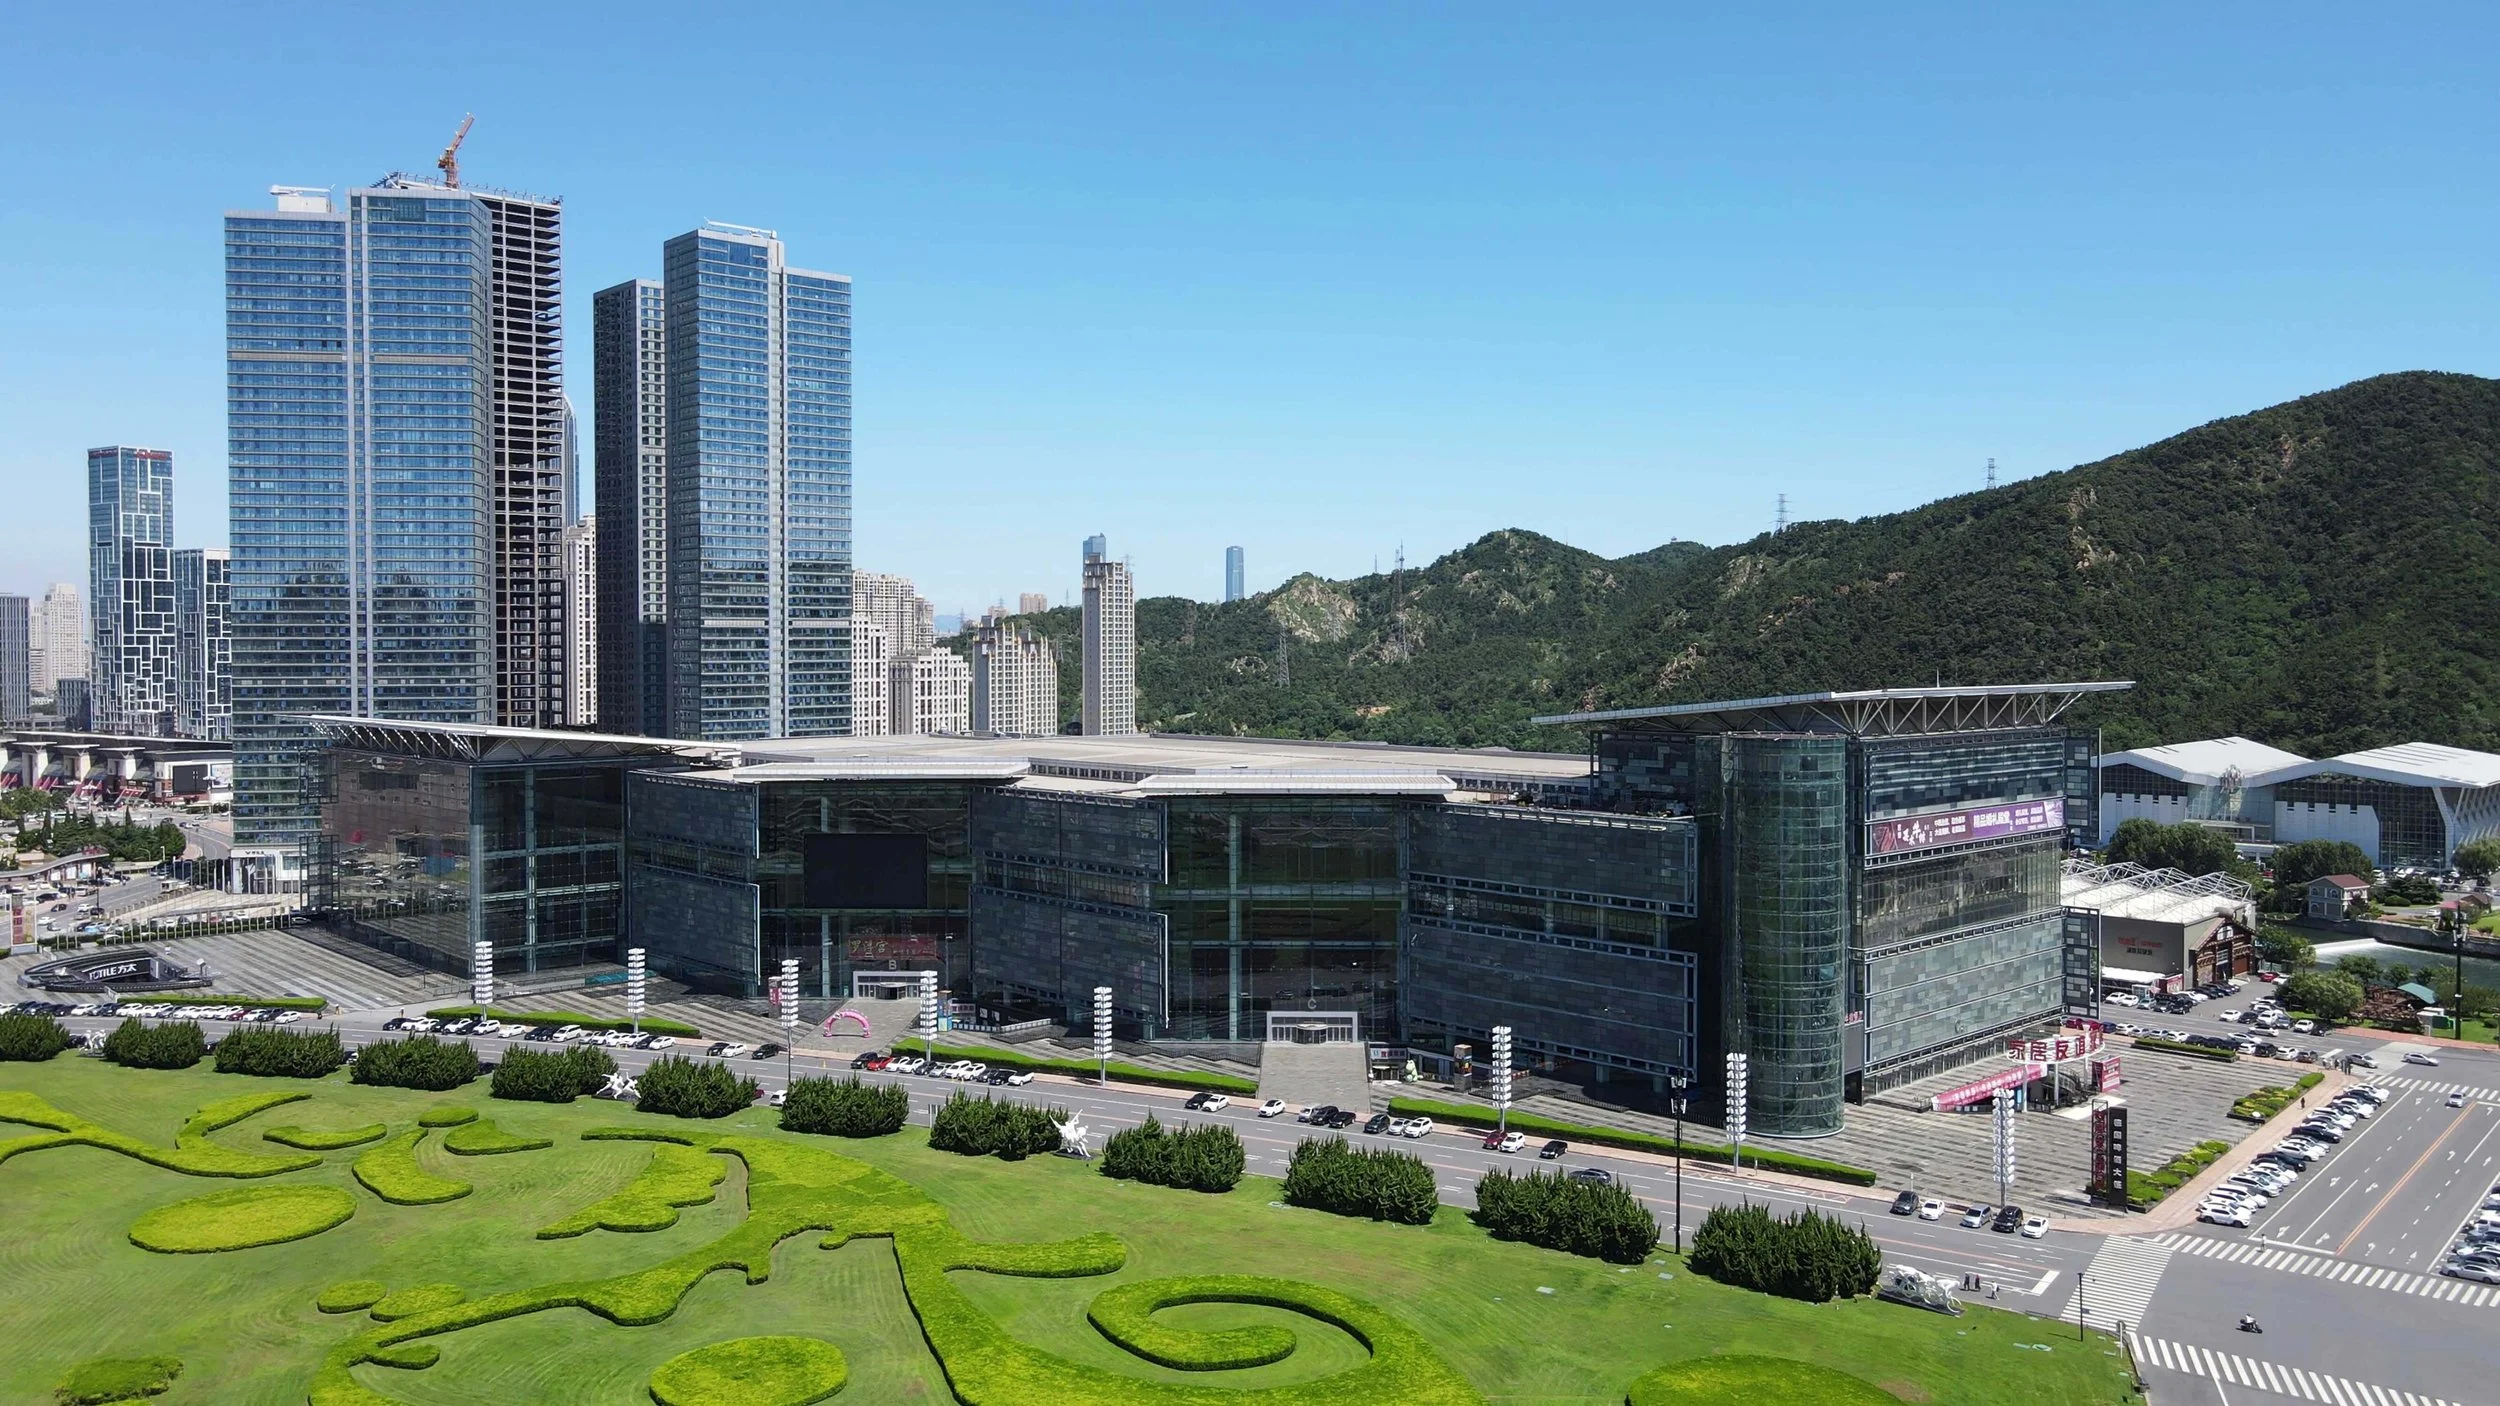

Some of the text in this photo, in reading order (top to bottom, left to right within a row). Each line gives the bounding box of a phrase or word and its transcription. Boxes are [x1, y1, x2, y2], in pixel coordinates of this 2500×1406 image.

[888, 959, 897, 970] B
[89, 963, 137, 980] FOTILE 方太
[1307, 998, 1317, 1010] C
